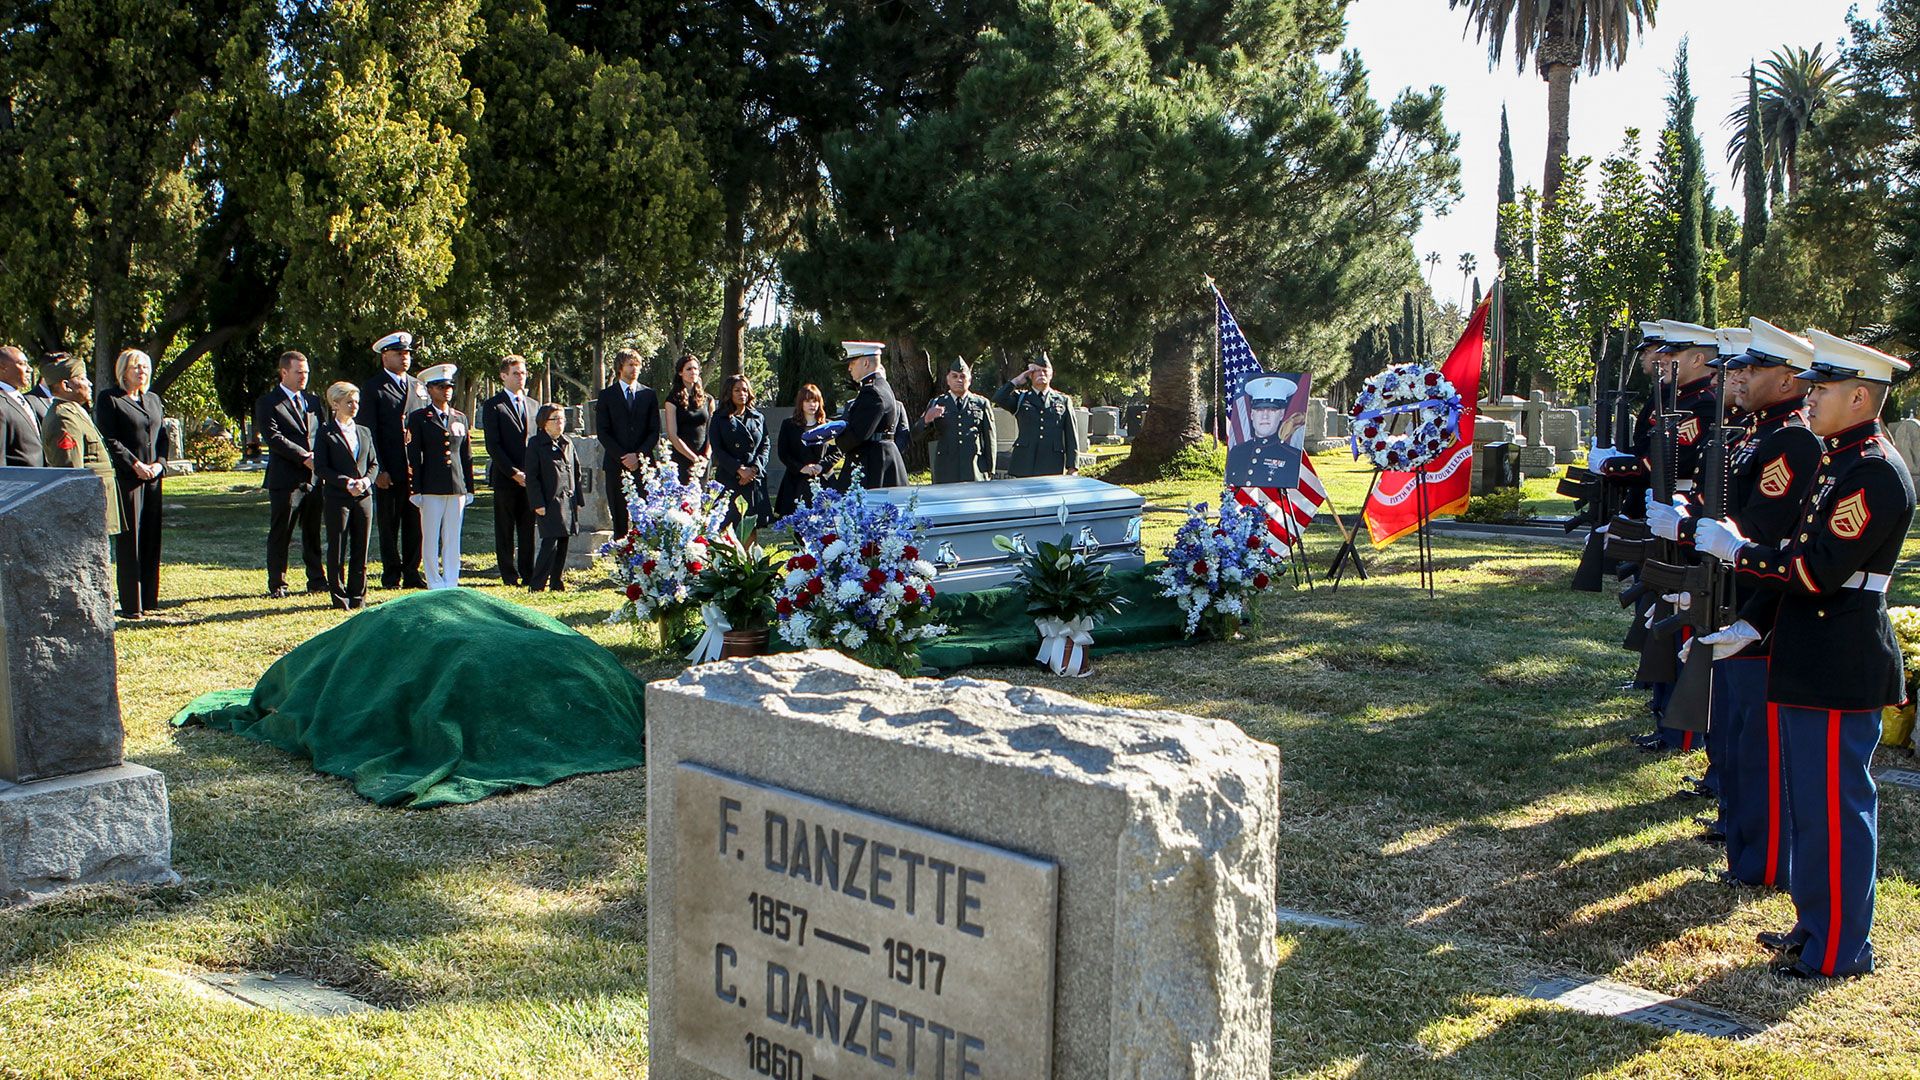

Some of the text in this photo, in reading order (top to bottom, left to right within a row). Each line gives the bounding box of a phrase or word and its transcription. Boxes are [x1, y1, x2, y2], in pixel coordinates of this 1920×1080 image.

[1390, 449, 1471, 504] FIFTH BATON FOURTEENTH
[719, 796, 986, 938] F. DANZETTE
[748, 891, 808, 947] 1857
[882, 937, 946, 996] 1917
[715, 942, 986, 1080] C. DANZETTE
[744, 1032, 804, 1080] 1860
